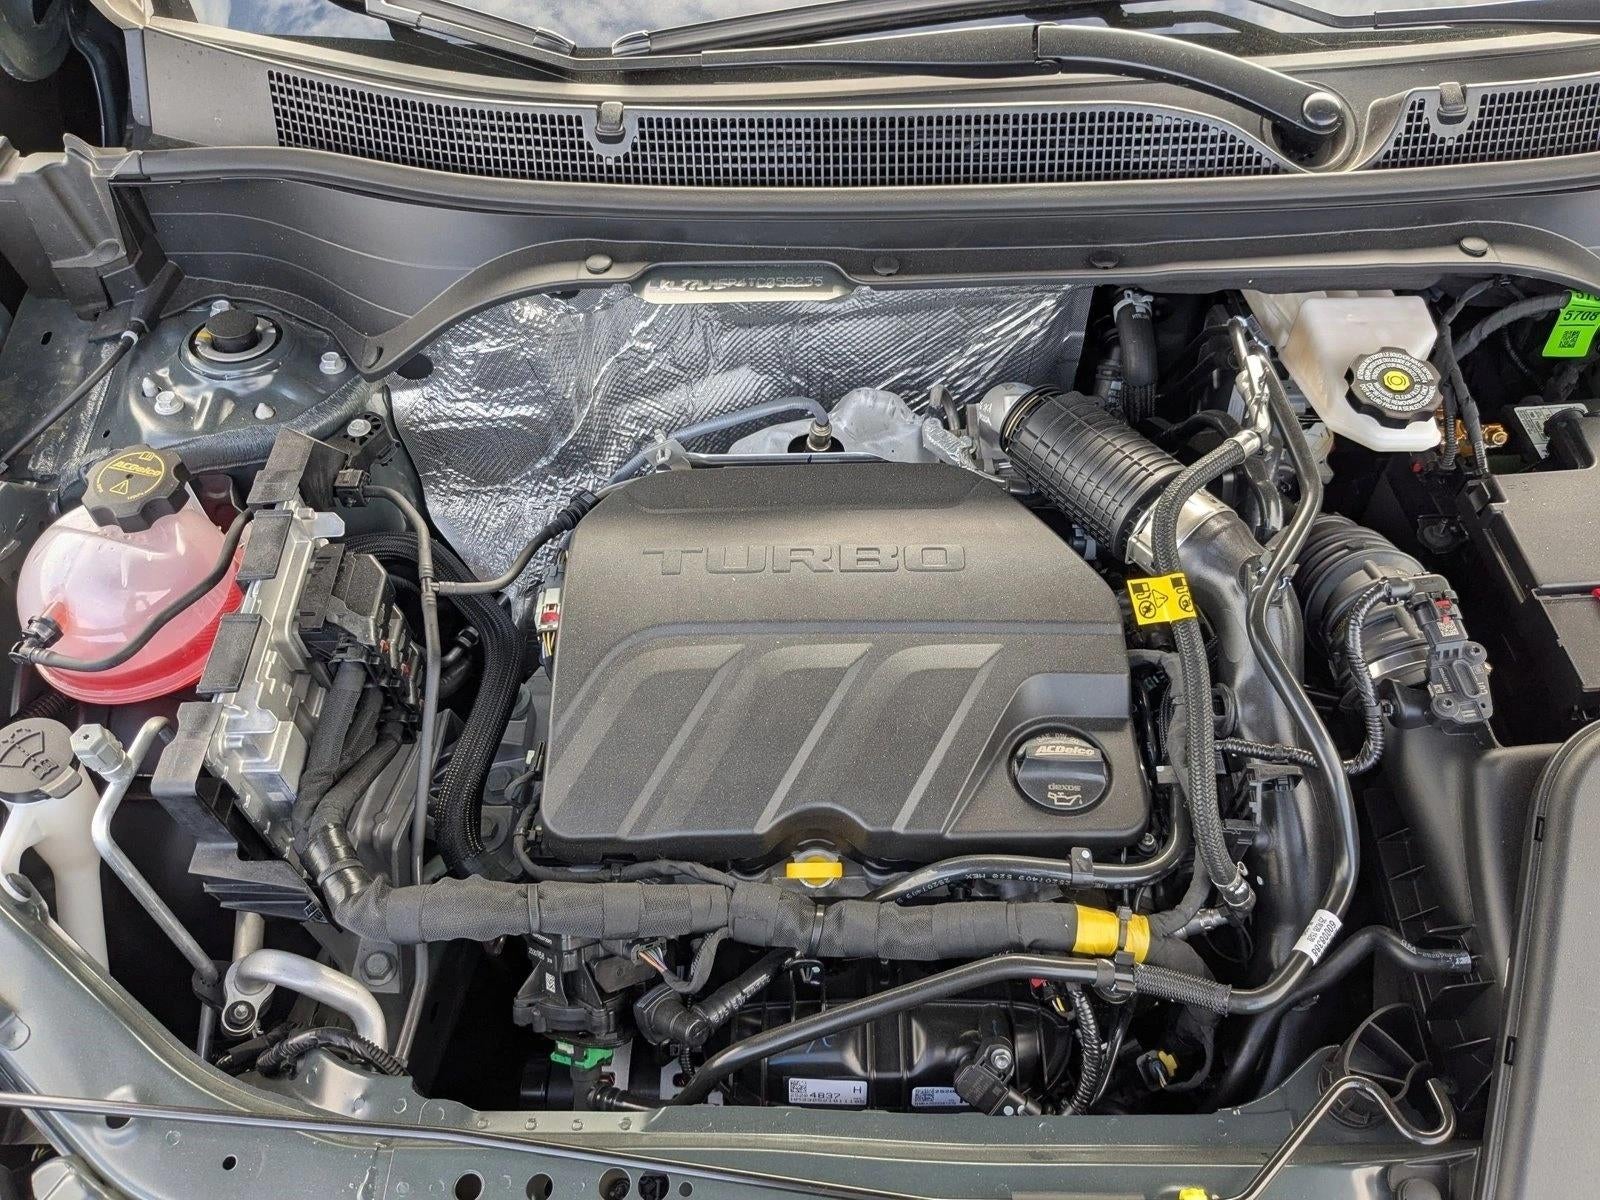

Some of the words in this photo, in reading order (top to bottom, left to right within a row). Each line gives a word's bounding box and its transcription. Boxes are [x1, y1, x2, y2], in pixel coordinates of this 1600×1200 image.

[642, 543, 966, 576] TURBO
[1035, 744, 1095, 756] ACDelco
[1047, 782, 1082, 792] dexos
[852, 1085, 862, 1094] H
[809, 1091, 841, 1099] 4837
